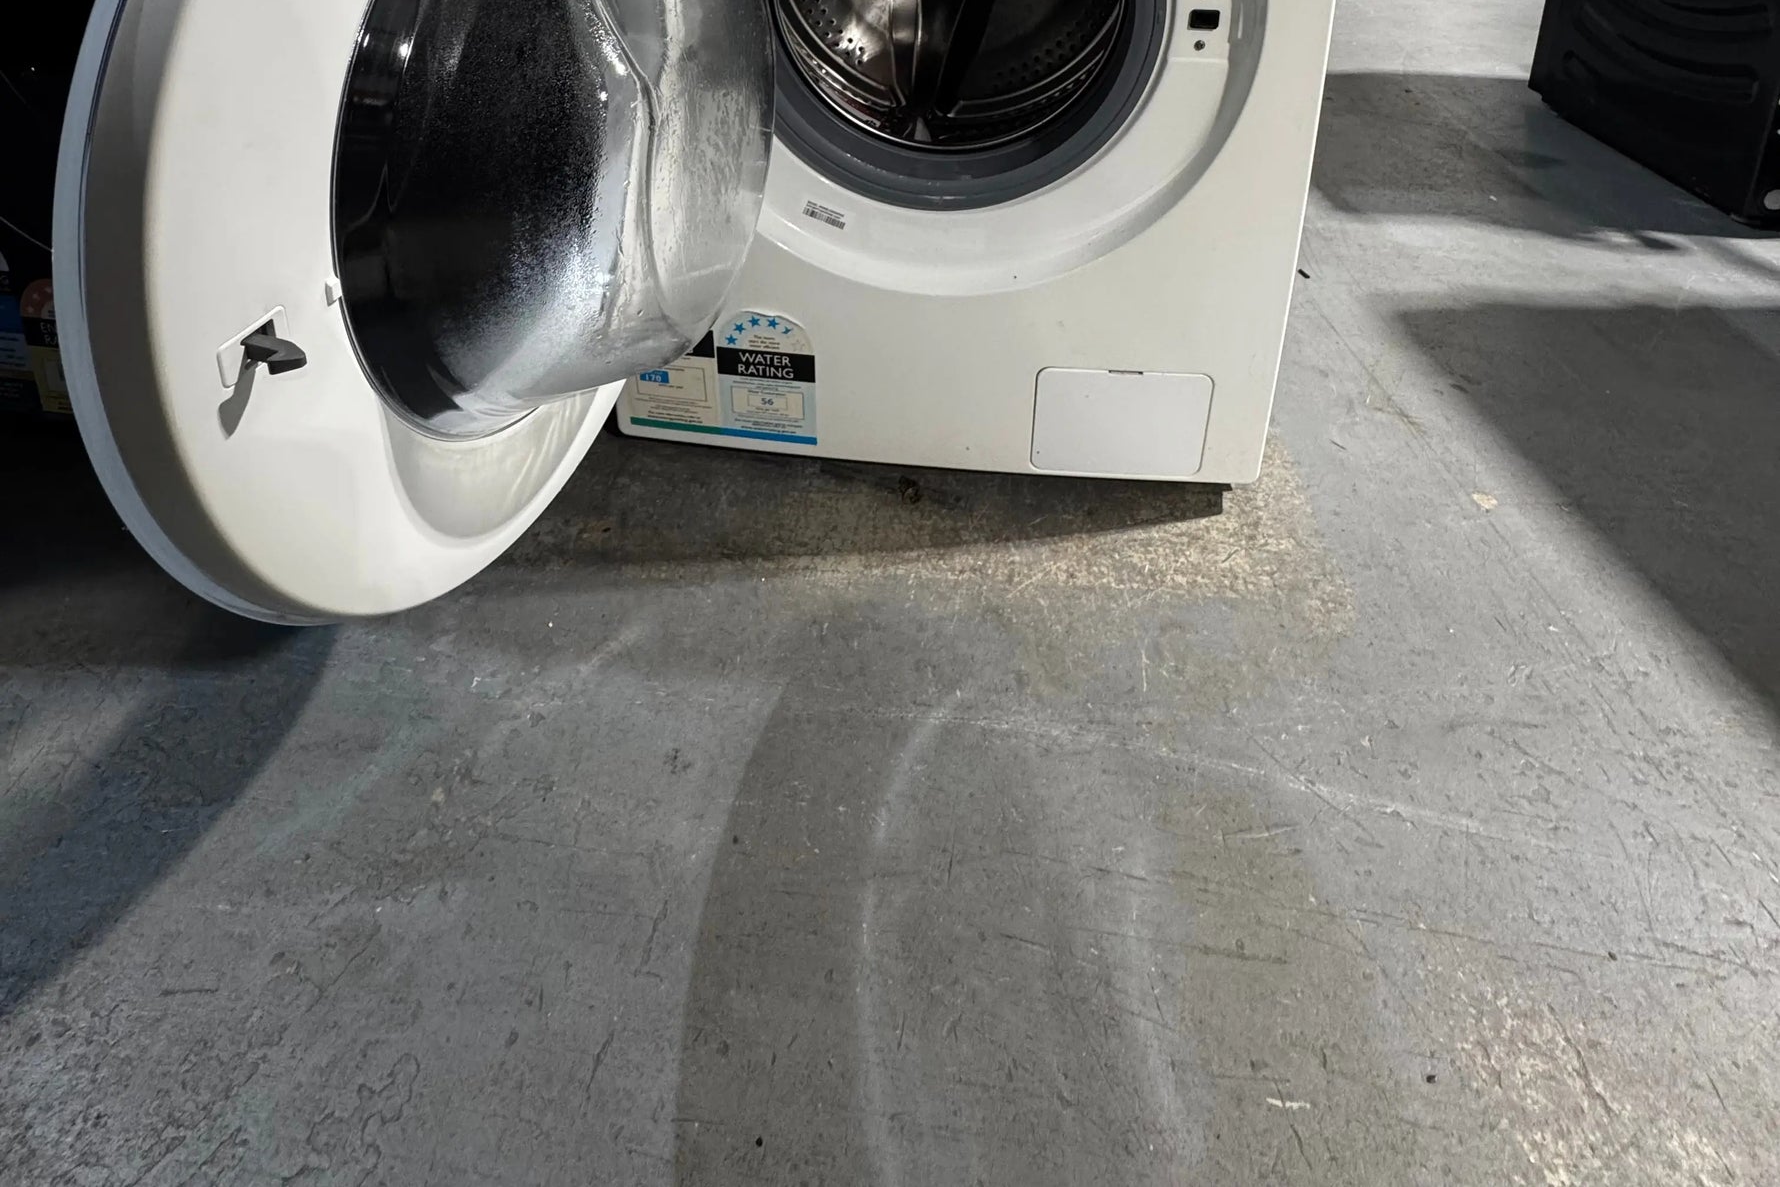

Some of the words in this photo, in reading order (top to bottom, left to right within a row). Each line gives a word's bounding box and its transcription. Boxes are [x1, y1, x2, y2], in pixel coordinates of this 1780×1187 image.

[738, 351, 792, 367] WATER
[737, 363, 794, 379] RATING
[761, 397, 774, 406] 56
